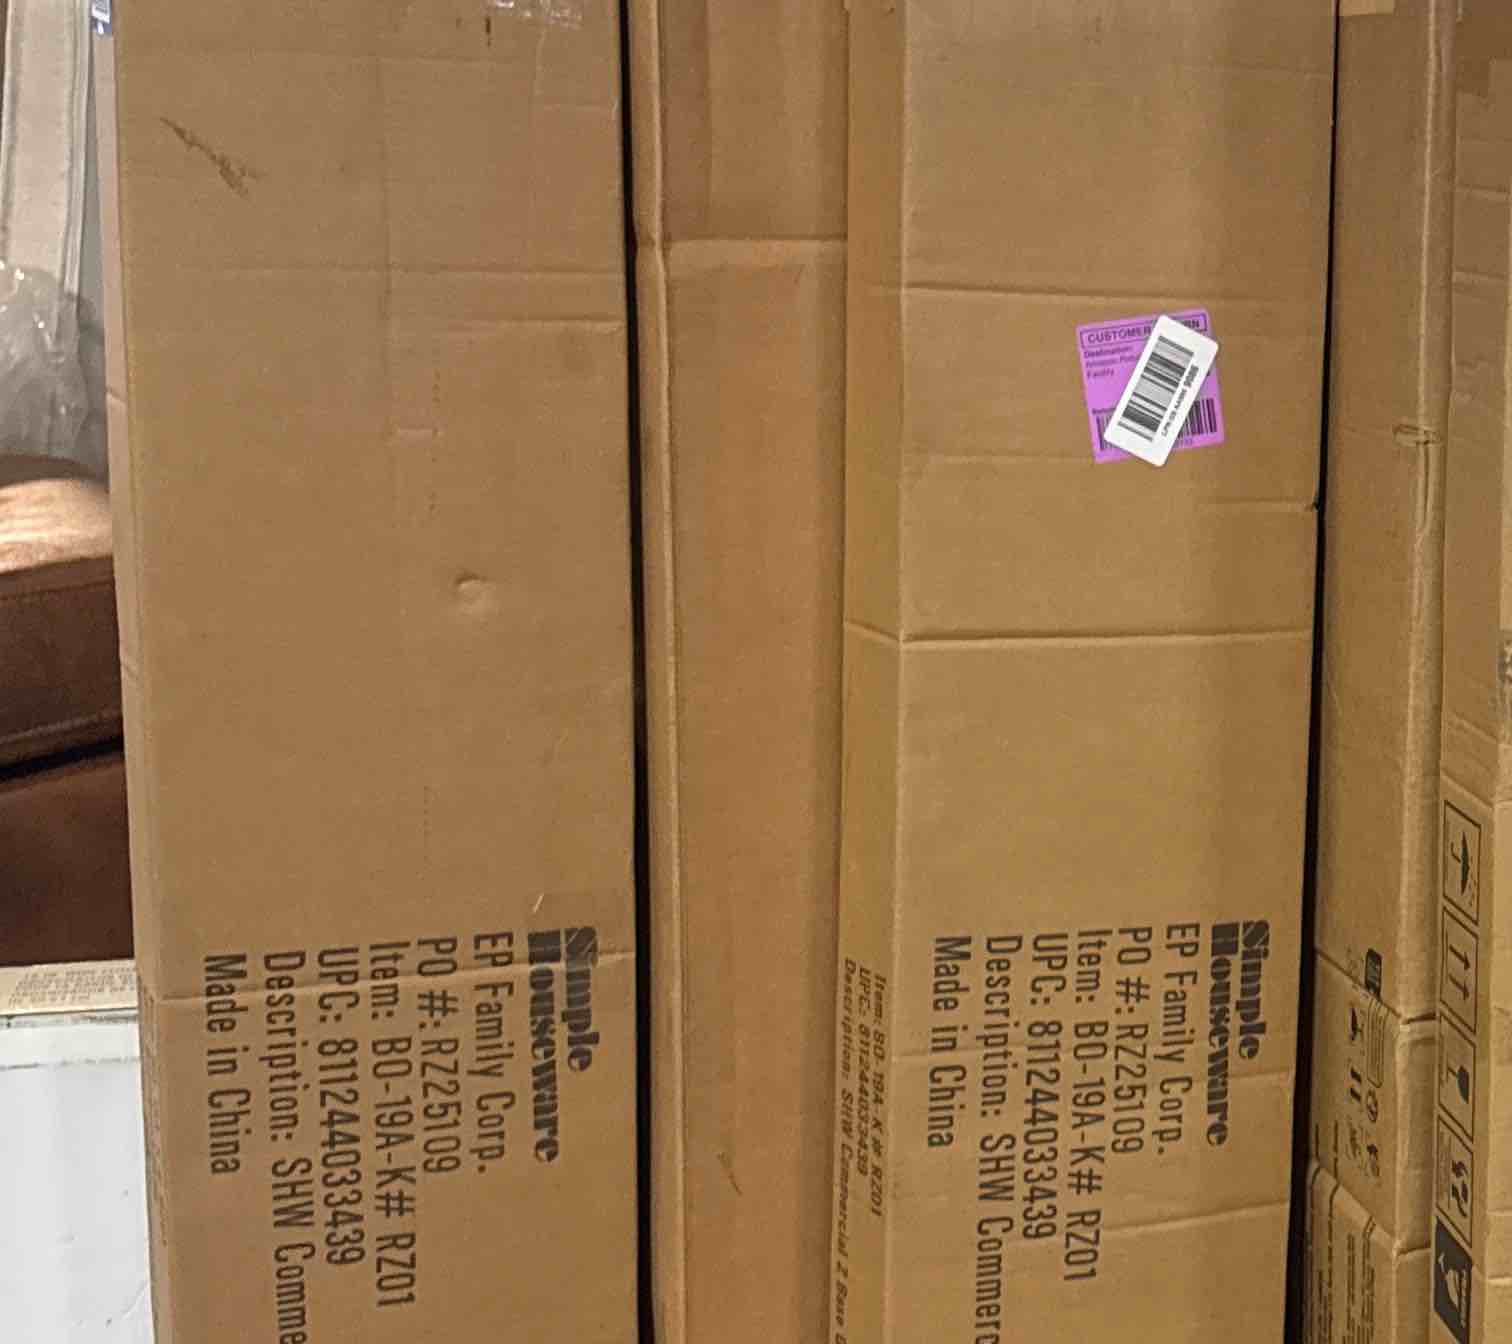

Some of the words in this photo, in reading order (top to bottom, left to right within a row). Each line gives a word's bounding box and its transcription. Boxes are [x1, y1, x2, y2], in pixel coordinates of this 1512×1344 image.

[417, 938, 458, 976] PO
[474, 931, 513, 968] EP
[933, 937, 972, 1012] Made
[1029, 933, 1068, 1005] UPC:
[1074, 929, 1112, 1004] Item:
[1118, 927, 1152, 965] PO
[1165, 923, 1200, 957] EP
[205, 954, 248, 1032] Made
[317, 948, 360, 1023] UPC:
[370, 942, 410, 1020] Item:
[418, 990, 458, 1032] #:
[562, 927, 599, 1072] Simple
[841, 958, 856, 1081] Description:
[873, 974, 886, 1024] Item:
[1115, 977, 1150, 1014] #:
[1154, 971, 1198, 1063] Family
[1236, 920, 1269, 1059] Simple
[206, 1046, 250, 1076] in
[260, 951, 310, 1141] Description:
[468, 981, 514, 1077] Family
[528, 929, 562, 1163] Houseware
[930, 1024, 968, 1053] in
[976, 935, 1023, 1117] Description:
[1206, 922, 1239, 1146] Houseware
[421, 1039, 461, 1173] RZ25109
[841, 1089, 853, 1139] SHW
[927, 1064, 967, 1147] China
[1111, 1024, 1148, 1153] RZ25109
[1151, 1077, 1192, 1155] Corp.
[207, 1088, 252, 1175] China
[317, 1039, 366, 1265] 811244033439
[469, 1091, 516, 1174] Corp.
[978, 1133, 1016, 1201] SHW
[1022, 1021, 1063, 1240] 811244033439
[272, 1158, 314, 1228] SHW
[837, 1144, 854, 1258] Commercial
[376, 1233, 417, 1309] RZ01
[1064, 1210, 1102, 1282] RZ01
[836, 1279, 848, 1327] Base
